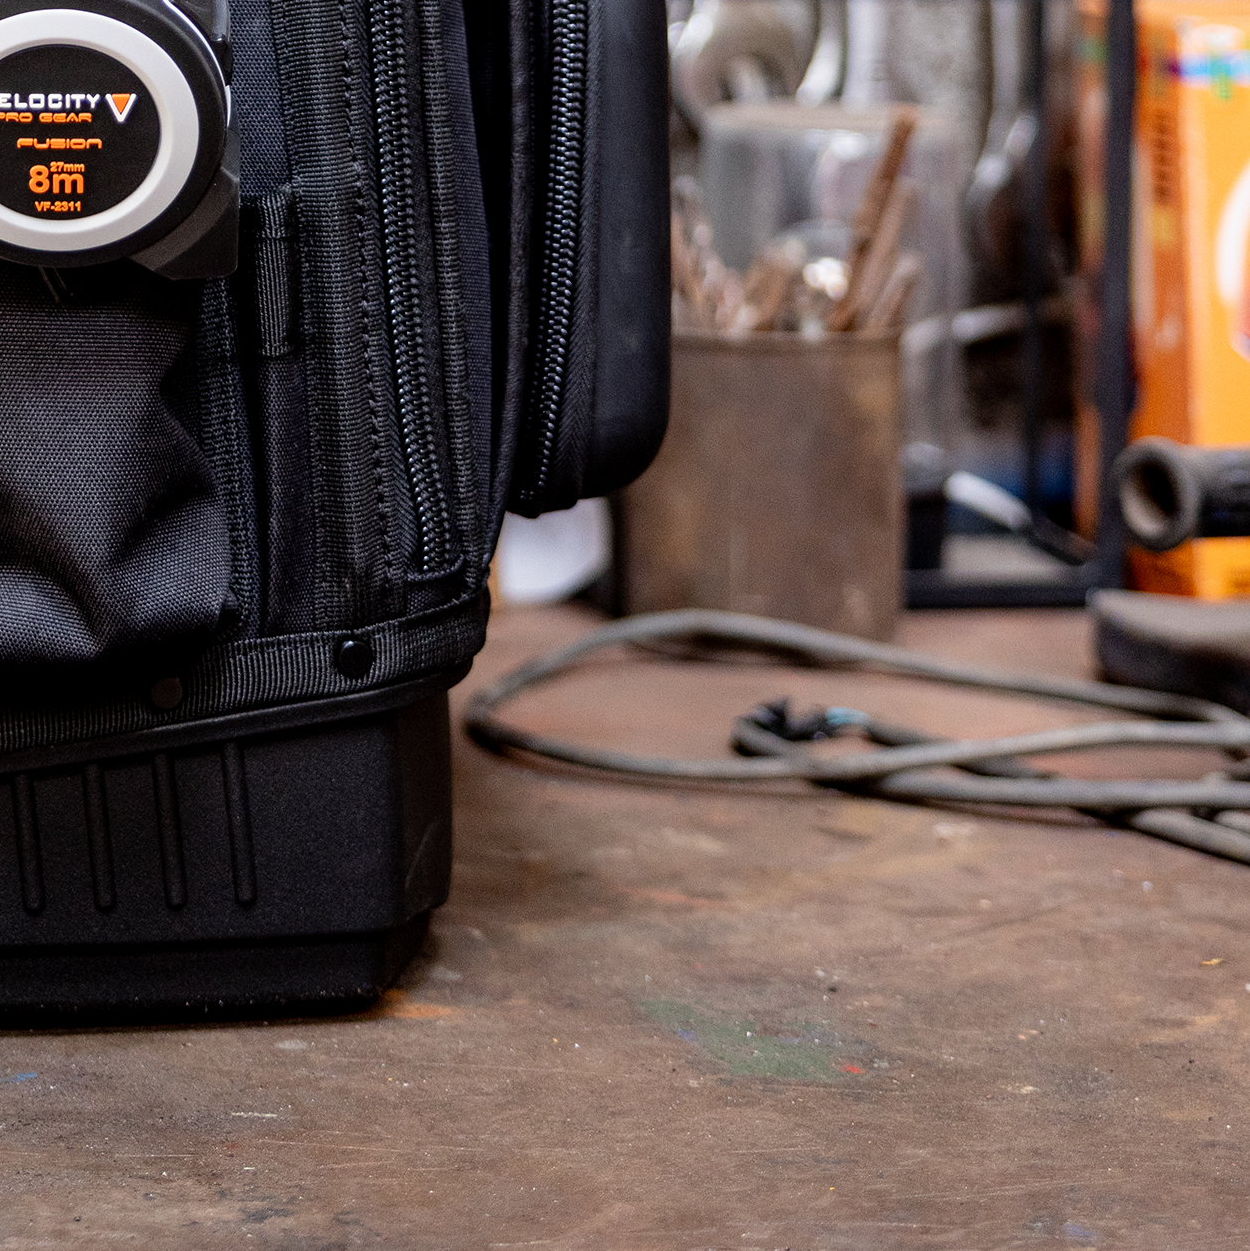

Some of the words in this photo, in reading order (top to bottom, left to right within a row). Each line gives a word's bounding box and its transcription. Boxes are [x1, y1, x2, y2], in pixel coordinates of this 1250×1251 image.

[39, 112, 92, 123] GEAR
[16, 137, 102, 149] FUSION
[50, 161, 85, 173] 27mm
[28, 164, 84, 194] 8m
[34, 201, 82, 212] VF-2311
